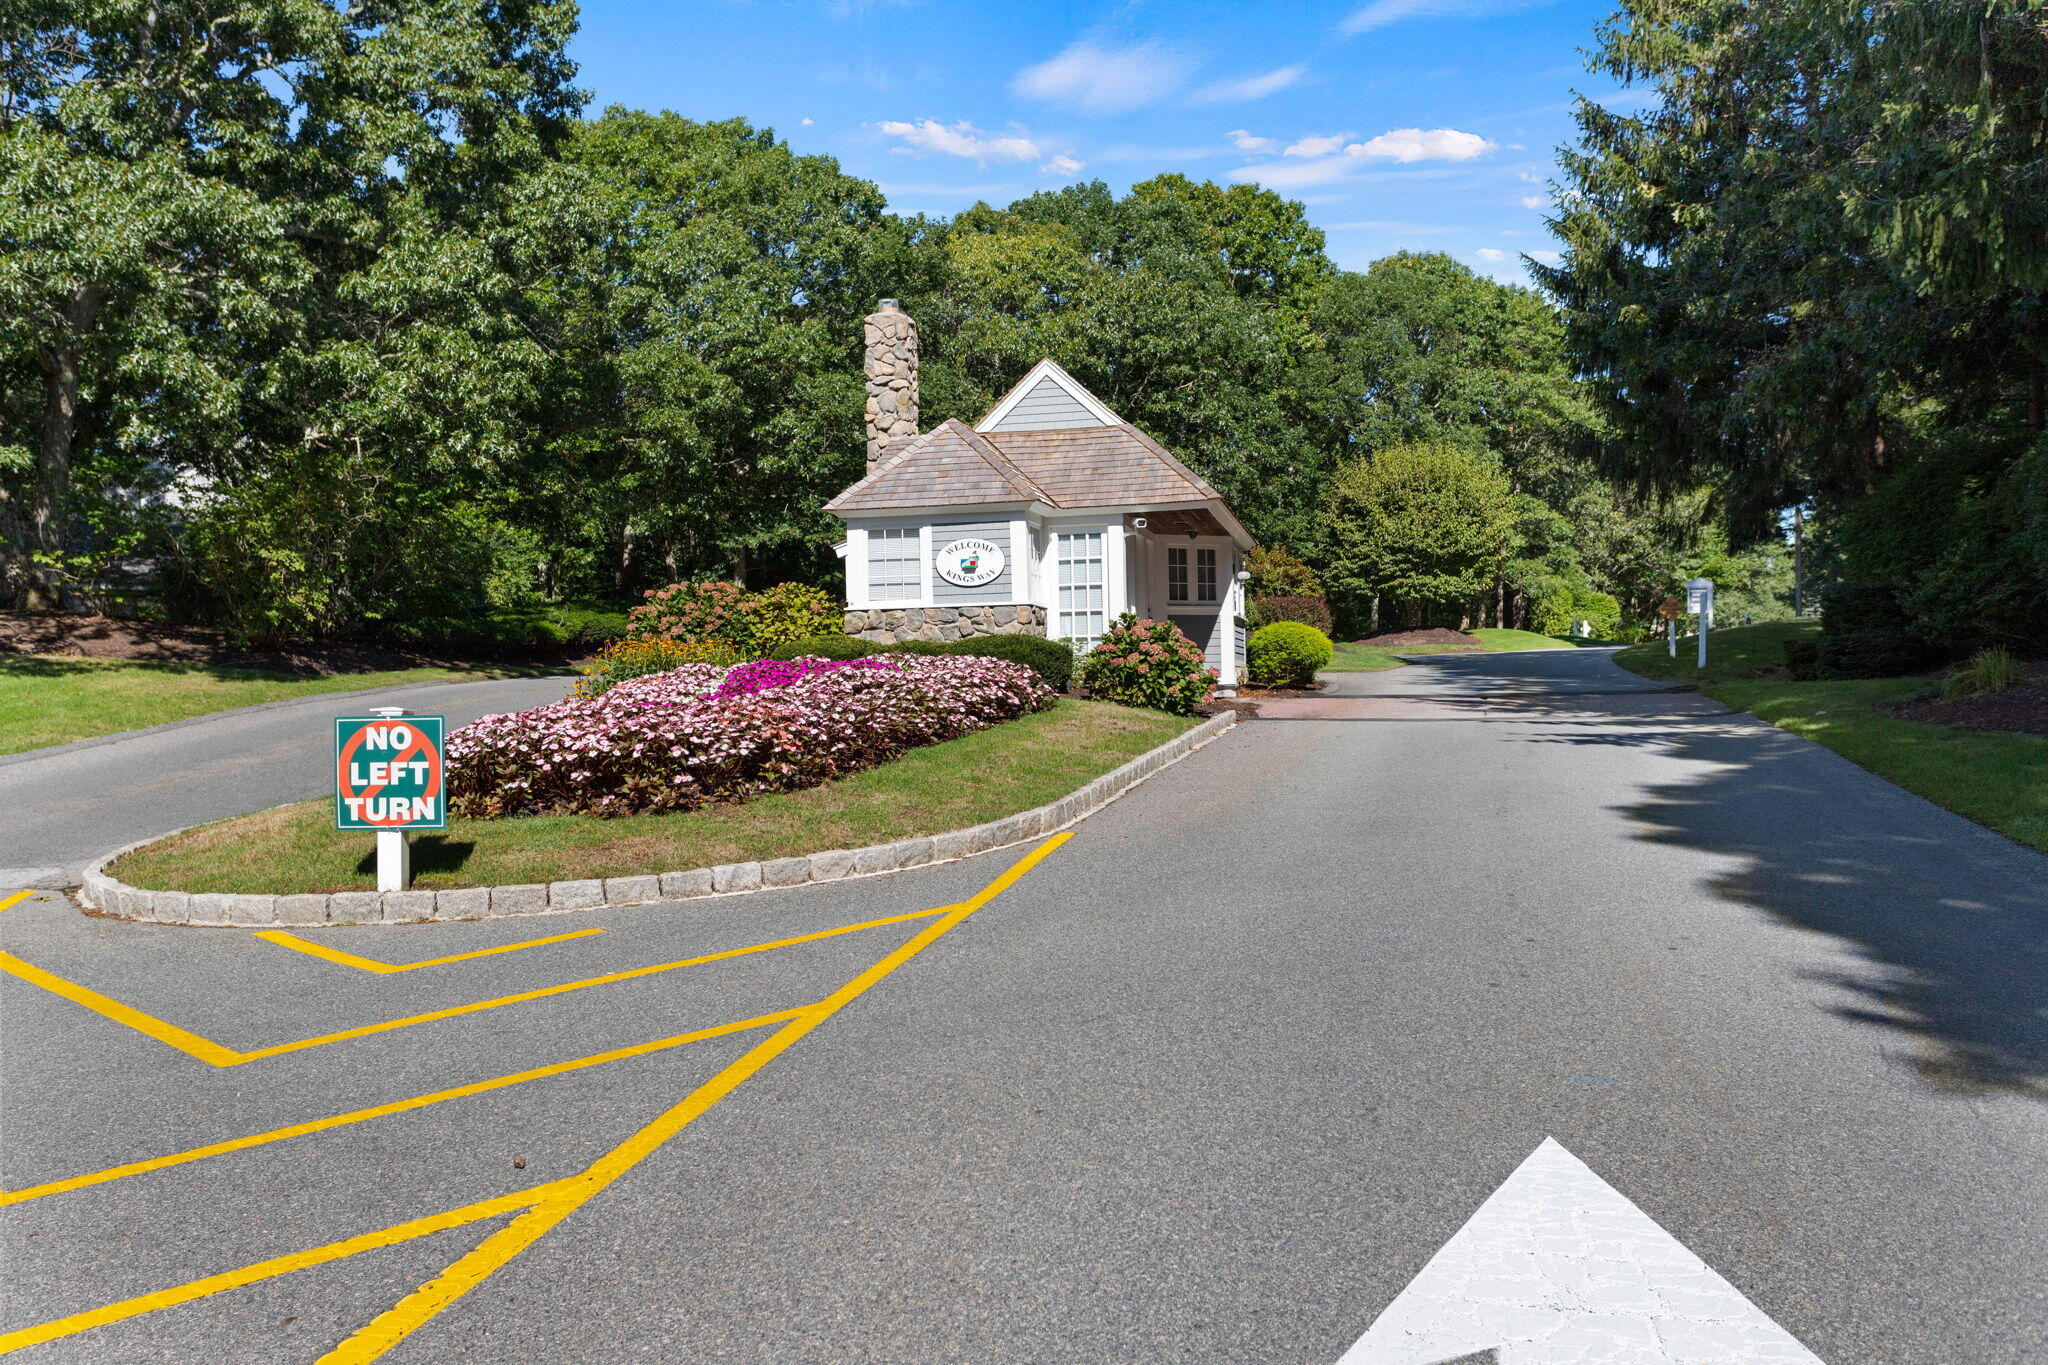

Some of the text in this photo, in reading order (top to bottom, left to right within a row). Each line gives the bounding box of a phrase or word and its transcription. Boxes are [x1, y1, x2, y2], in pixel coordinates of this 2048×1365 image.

[946, 541, 996, 555] WELCOME
[366, 726, 412, 750] NO
[351, 761, 429, 785] LEFT
[345, 797, 435, 821] TURN
